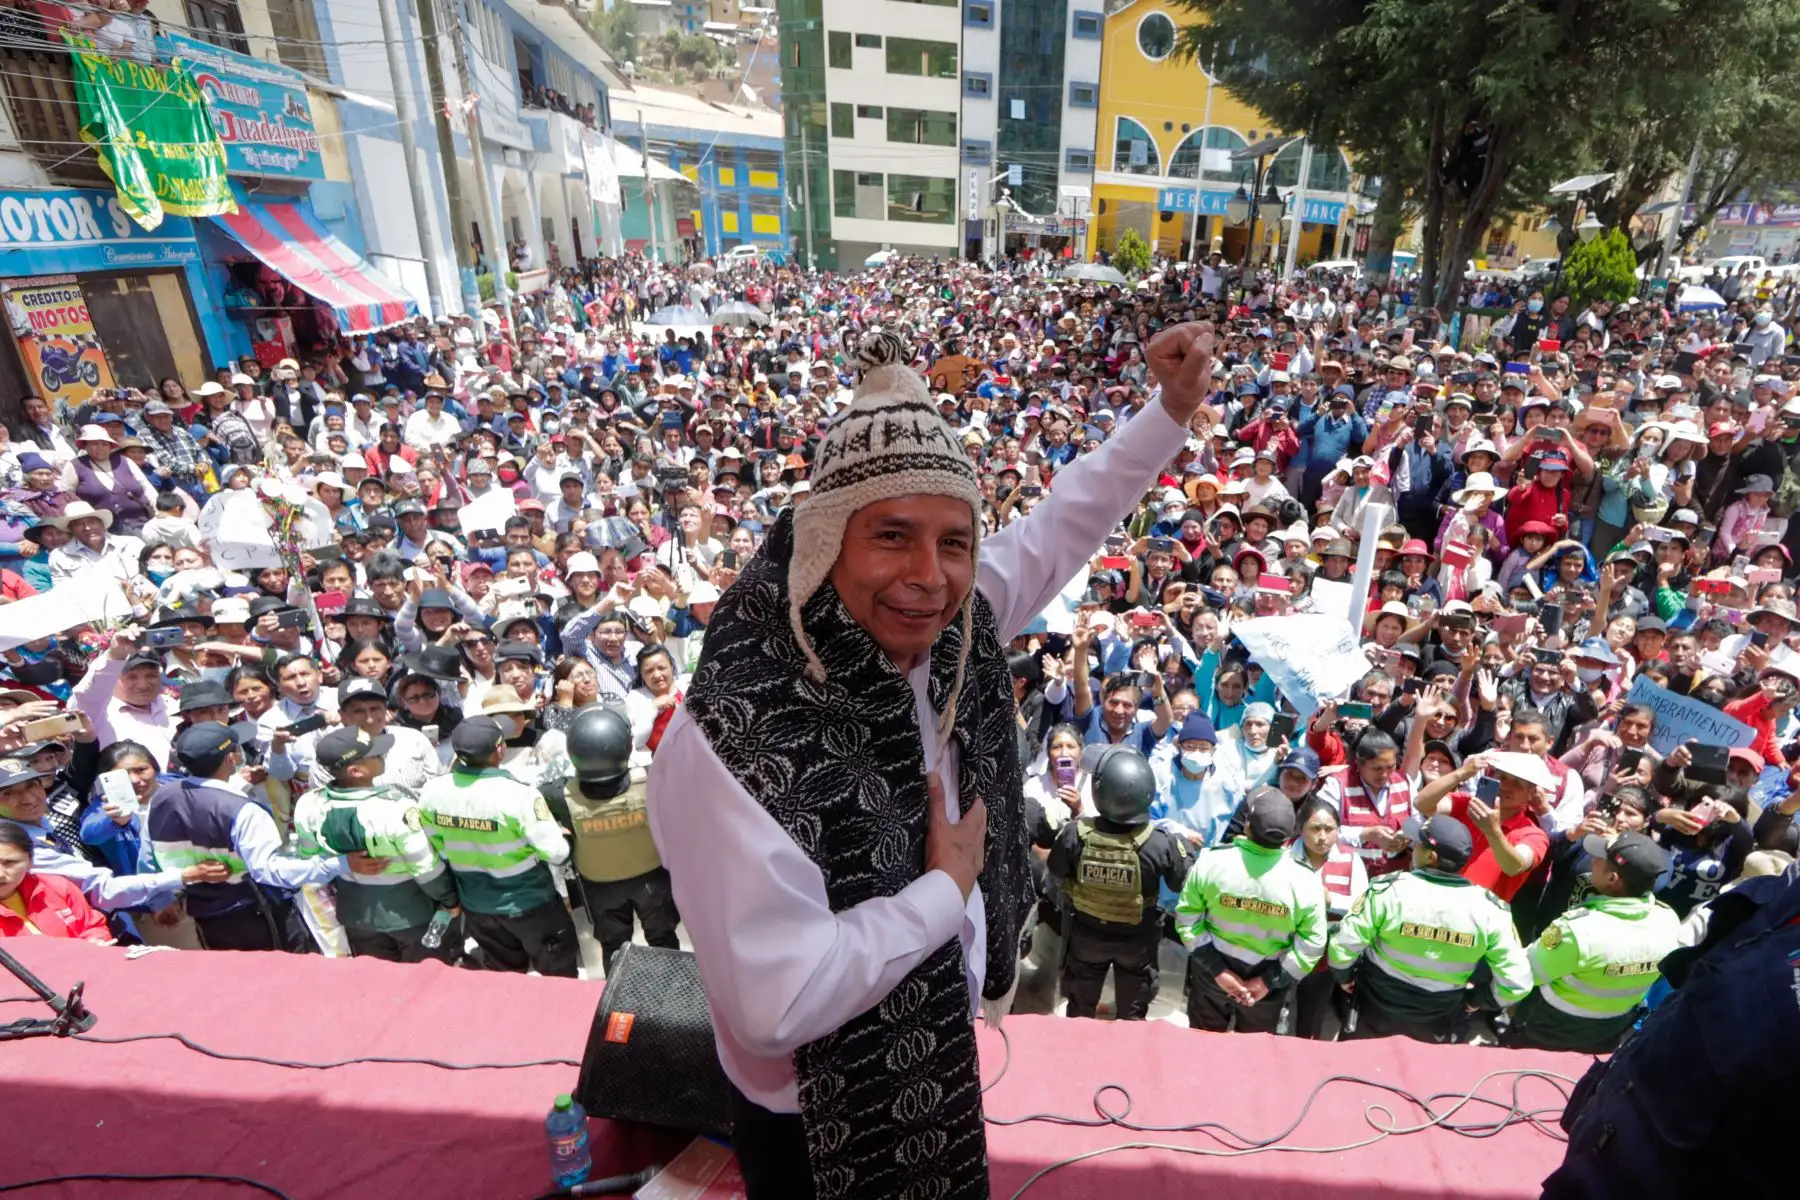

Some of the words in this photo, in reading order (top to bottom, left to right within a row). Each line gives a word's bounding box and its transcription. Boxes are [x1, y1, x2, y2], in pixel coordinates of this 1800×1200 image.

[970, 171, 978, 220] PLAZA
[0, 196, 131, 242] OTOR'S
[27, 305, 90, 329] MOTOS
[1633, 683, 1740, 745] NOMBRAMIENTO
[458, 817, 492, 831] PAUCAR
